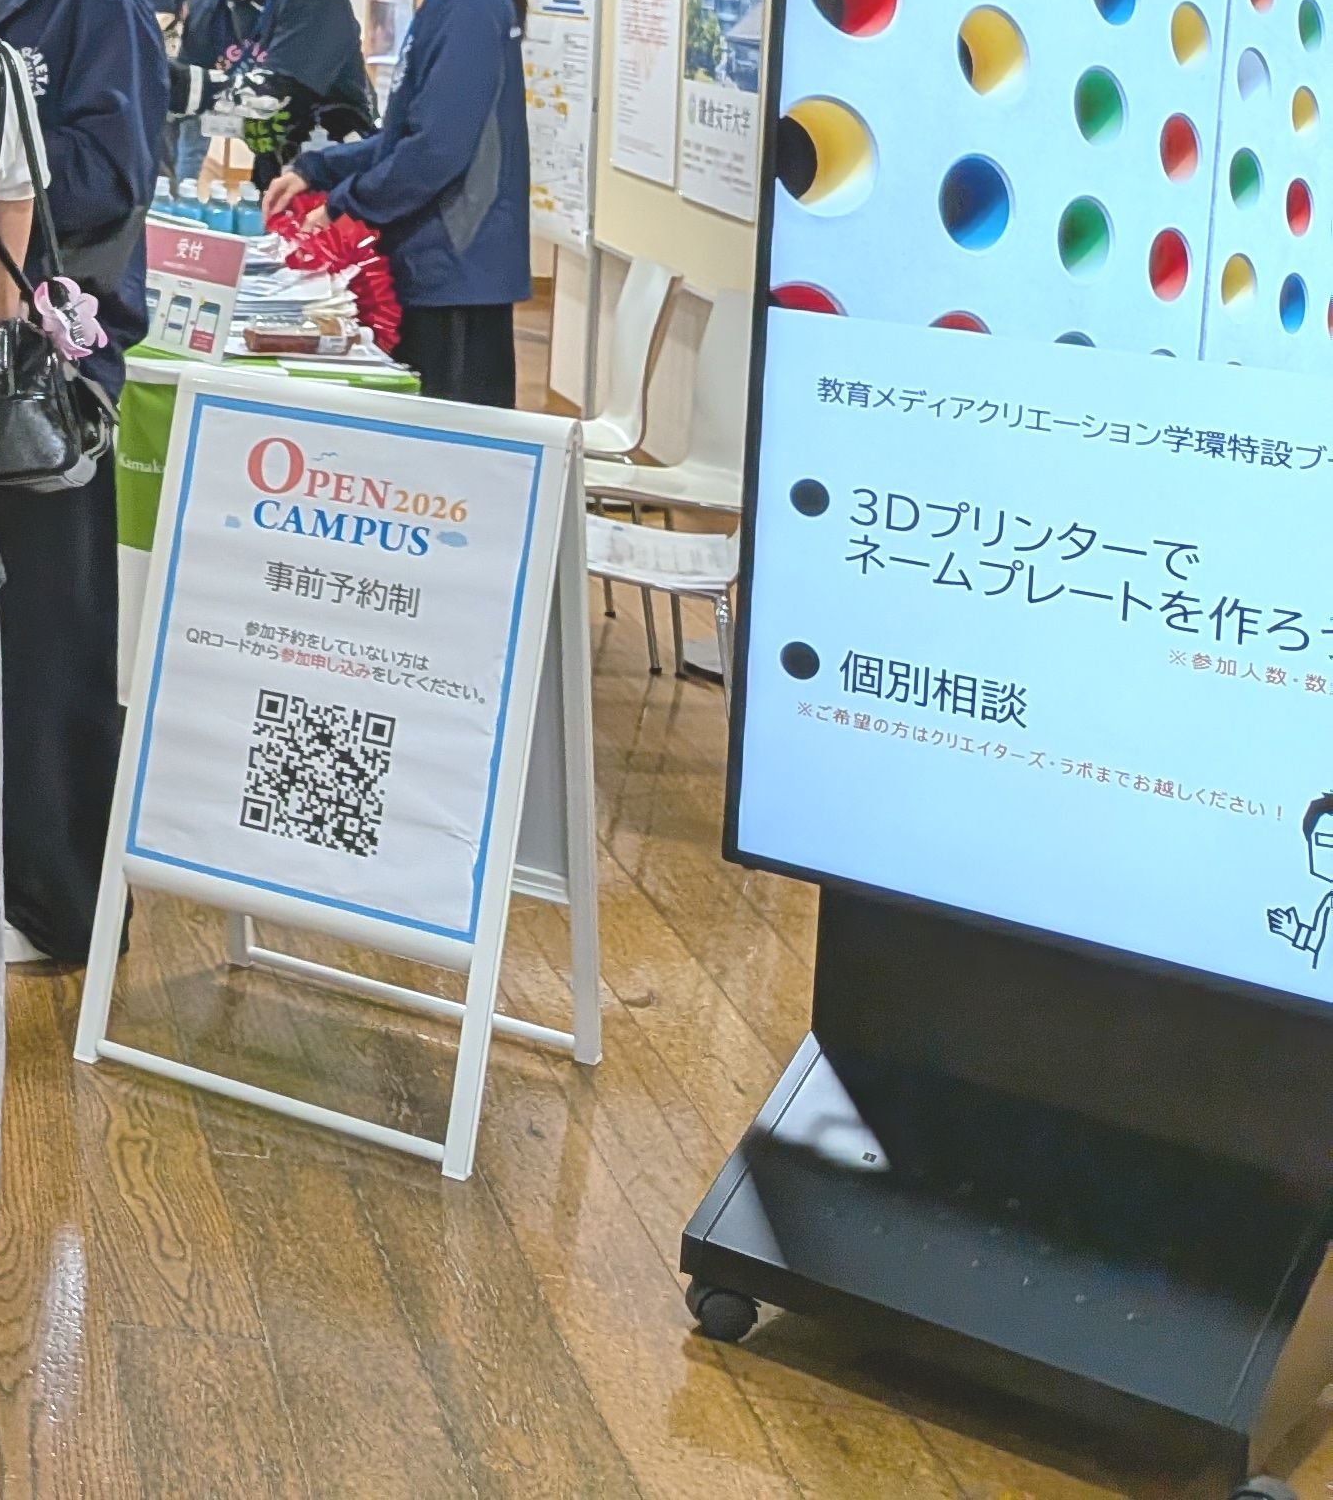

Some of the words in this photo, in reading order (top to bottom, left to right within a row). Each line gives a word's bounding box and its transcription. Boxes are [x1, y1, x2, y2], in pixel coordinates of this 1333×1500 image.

[175, 238, 204, 260] 受付
[817, 375, 1333, 471] 教育メディアクリエーション学環特設ブ
[246, 436, 393, 511] OPEN
[393, 488, 469, 524] 2026
[252, 499, 432, 557] CAMPUS
[849, 487, 1200, 581] 3Dプリンターで
[264, 561, 422, 619] 事前予約制
[185, 627, 486, 705] QRコードから参加申し込みをしてください。
[244, 620, 430, 672] 参加予約をしていない方は
[1168, 649, 1333, 695] ※参加人数・数
[839, 649, 1029, 730] 個別相談
